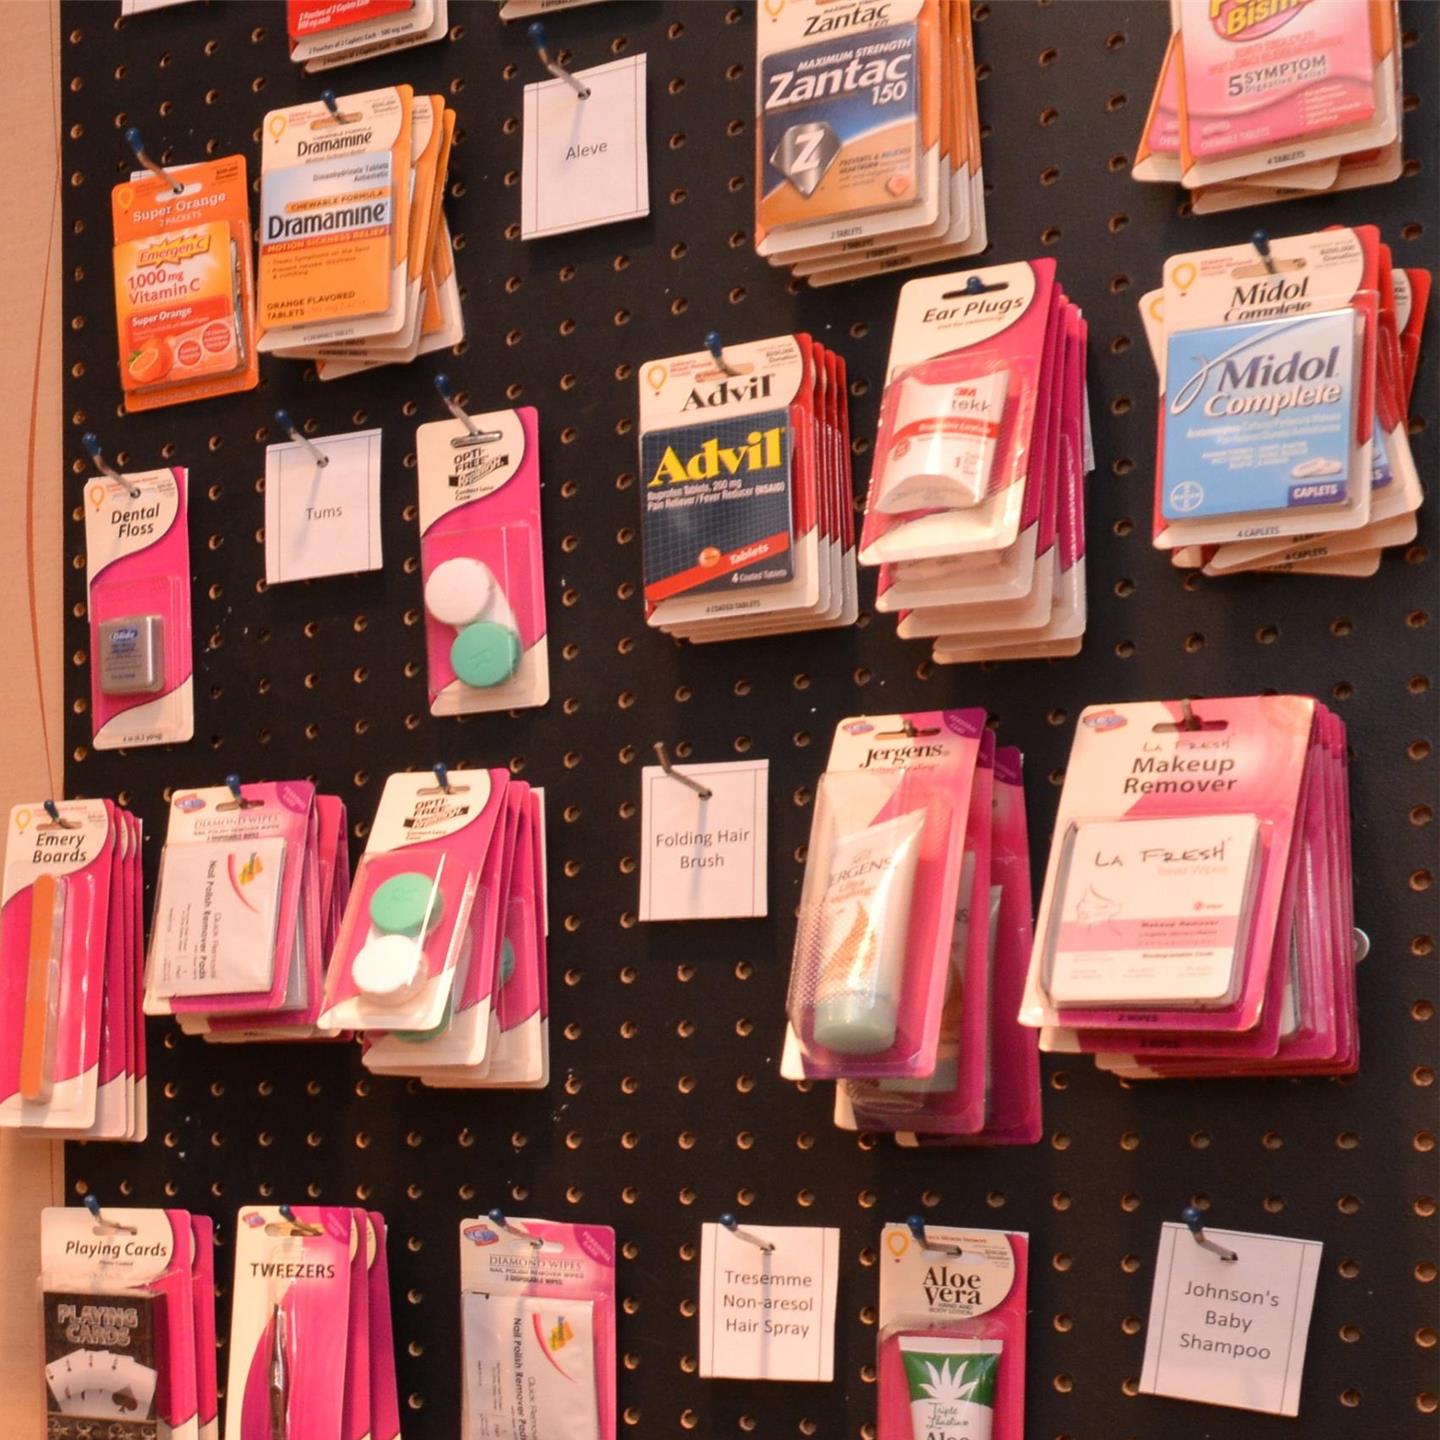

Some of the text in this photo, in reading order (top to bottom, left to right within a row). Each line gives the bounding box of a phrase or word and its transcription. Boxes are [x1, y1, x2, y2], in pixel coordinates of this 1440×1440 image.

[803, 3, 891, 37] Zantac
[1227, 0, 1308, 36] Bism
[797, 38, 912, 72] MAXIMUM STRENGTH
[765, 54, 912, 110] Zantac
[1228, 55, 1326, 97] 5 SYMPTOM
[871, 80, 908, 107] 150
[297, 130, 372, 157] Dramamine
[566, 141, 608, 161] Aleve
[790, 129, 824, 174] Z
[133, 191, 227, 222] Super Orange
[340, 189, 384, 204] FORMULA
[267, 202, 388, 240] Dramamine
[836, 226, 862, 237] TABLETS
[168, 270, 184, 282] mg
[129, 278, 201, 305] Vitamin C
[1231, 275, 1310, 309] Midol
[922, 306, 960, 325] Ear
[963, 294, 1025, 319] Plugs
[1217, 346, 1340, 392] Midol
[680, 375, 773, 412] Advil
[1204, 382, 1343, 418] Complete
[648, 427, 784, 488] Advil
[1293, 484, 1338, 499] CAPLETS
[111, 502, 160, 526] Dental
[306, 505, 343, 521] Tums
[118, 523, 154, 539] Floss
[1244, 526, 1280, 537] CAPLETS
[730, 542, 769, 565] Tablets
[859, 743, 945, 769] Jergens
[1132, 755, 1235, 774] Makeup
[1123, 776, 1238, 795] Remover
[35, 832, 86, 850] Emery
[655, 828, 751, 848] Folding Hair
[32, 849, 87, 864] Boards
[680, 854, 724, 869] Brush
[1094, 839, 1226, 868] LA FRESH
[66, 1240, 168, 1259] Playing Cards
[250, 1262, 336, 1280] TWEEZERS
[489, 1255, 547, 1268] DIAMOND
[724, 1270, 812, 1288] Tresemme
[923, 1266, 982, 1288] Aloe
[723, 1294, 813, 1312] Non-aresol
[924, 1285, 982, 1305] Vera
[1184, 1281, 1280, 1307] Johnson's
[58, 1304, 139, 1328] PLAYING
[513, 1317, 522, 1335] Nail
[1205, 1310, 1253, 1333] Baby
[65, 1323, 132, 1346] CARDS
[726, 1318, 811, 1338] Hair Spray
[513, 1336, 523, 1368] Polish
[1179, 1333, 1272, 1359] Shampoo
[514, 1370, 526, 1417] Remover
